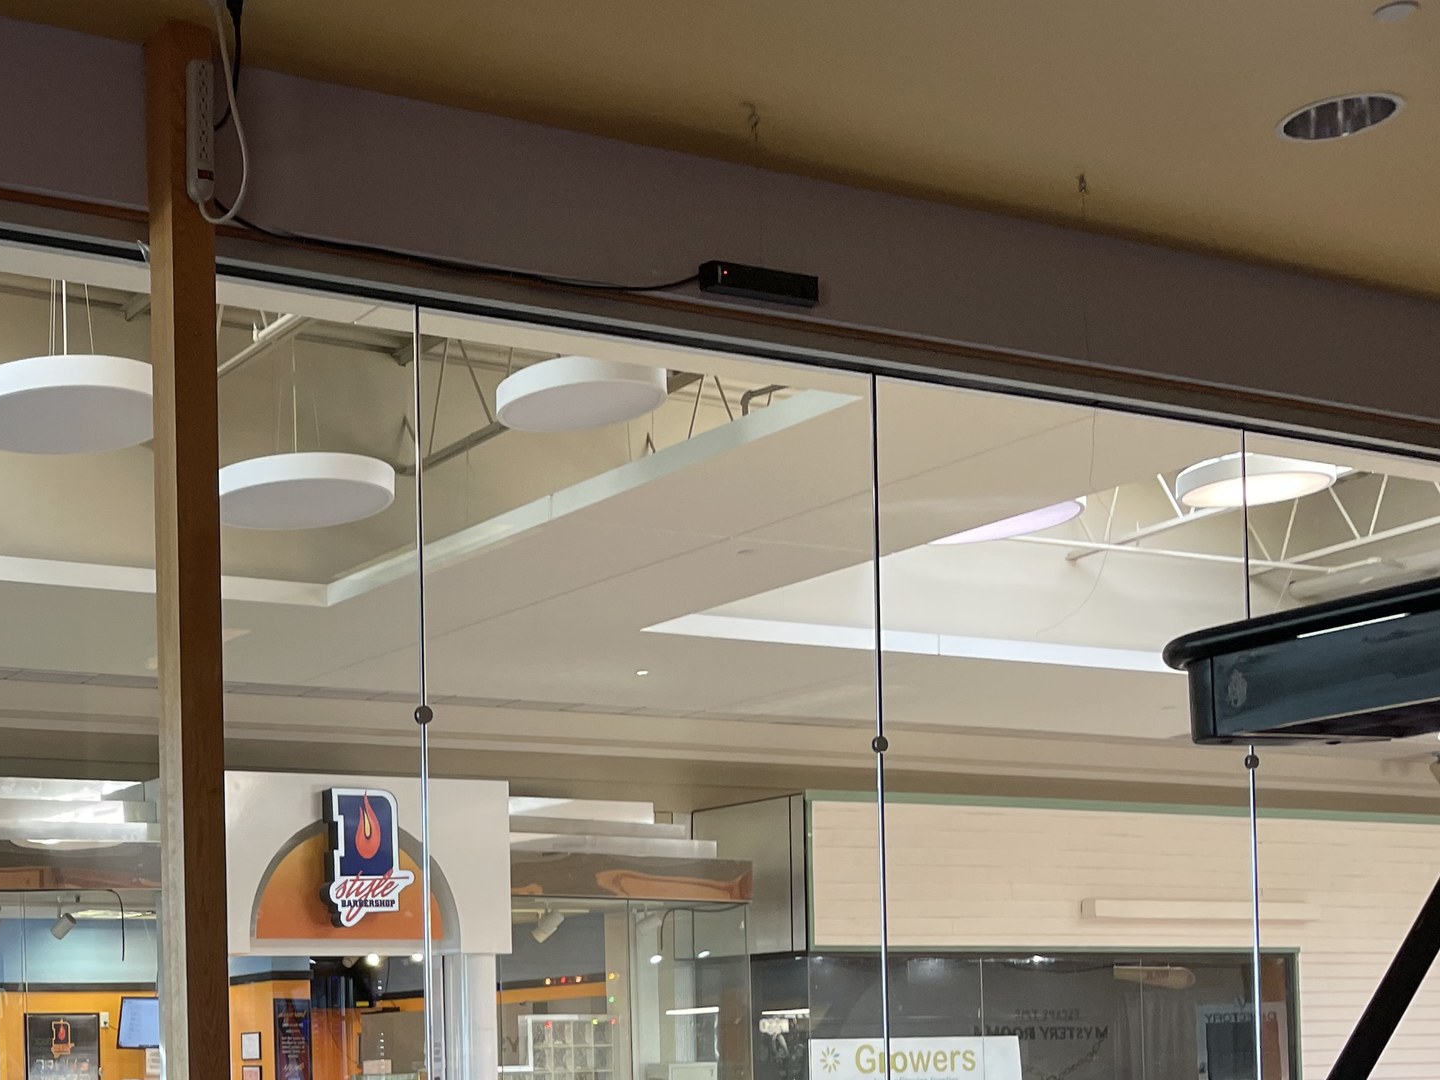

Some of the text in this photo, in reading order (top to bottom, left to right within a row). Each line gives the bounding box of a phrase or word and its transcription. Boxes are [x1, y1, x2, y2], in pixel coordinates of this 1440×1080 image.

[335, 868, 409, 922] style
[341, 899, 396, 908] BARBERSHOP
[855, 1044, 976, 1074] Growers
